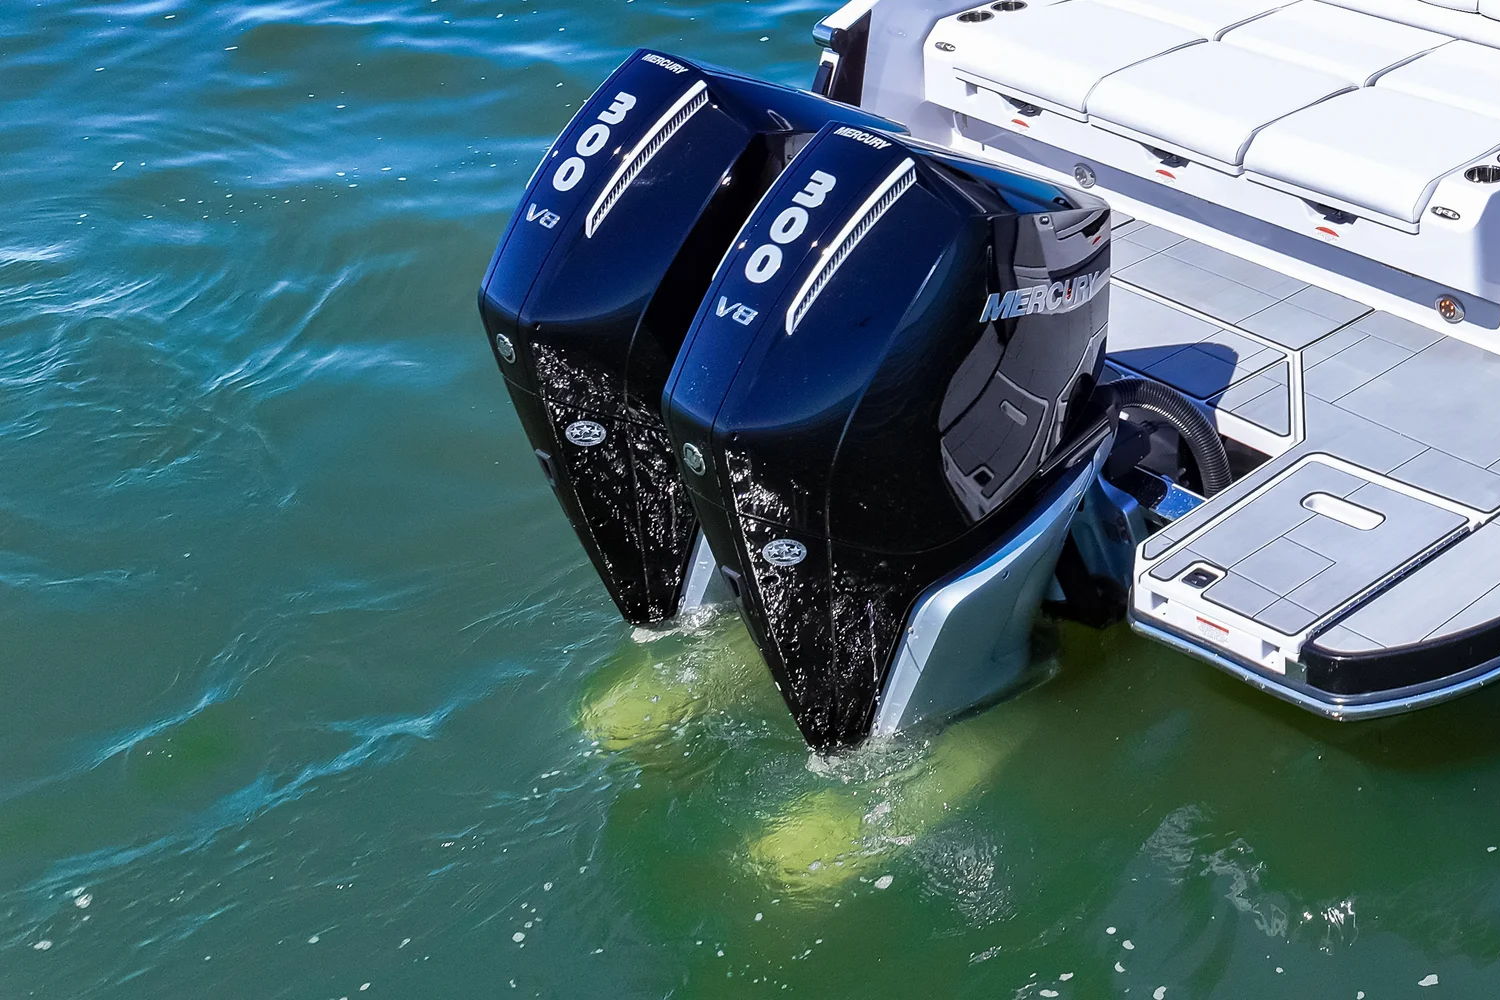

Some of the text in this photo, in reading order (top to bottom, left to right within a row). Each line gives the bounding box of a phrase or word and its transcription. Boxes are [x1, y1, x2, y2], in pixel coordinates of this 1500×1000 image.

[641, 53, 689, 74] MERCURY
[552, 91, 637, 192] 300
[833, 126, 892, 150] MERCURY
[525, 203, 561, 229] V8
[744, 169, 837, 284] 300
[715, 295, 759, 326] V8
[979, 270, 1100, 323] MERCURY
